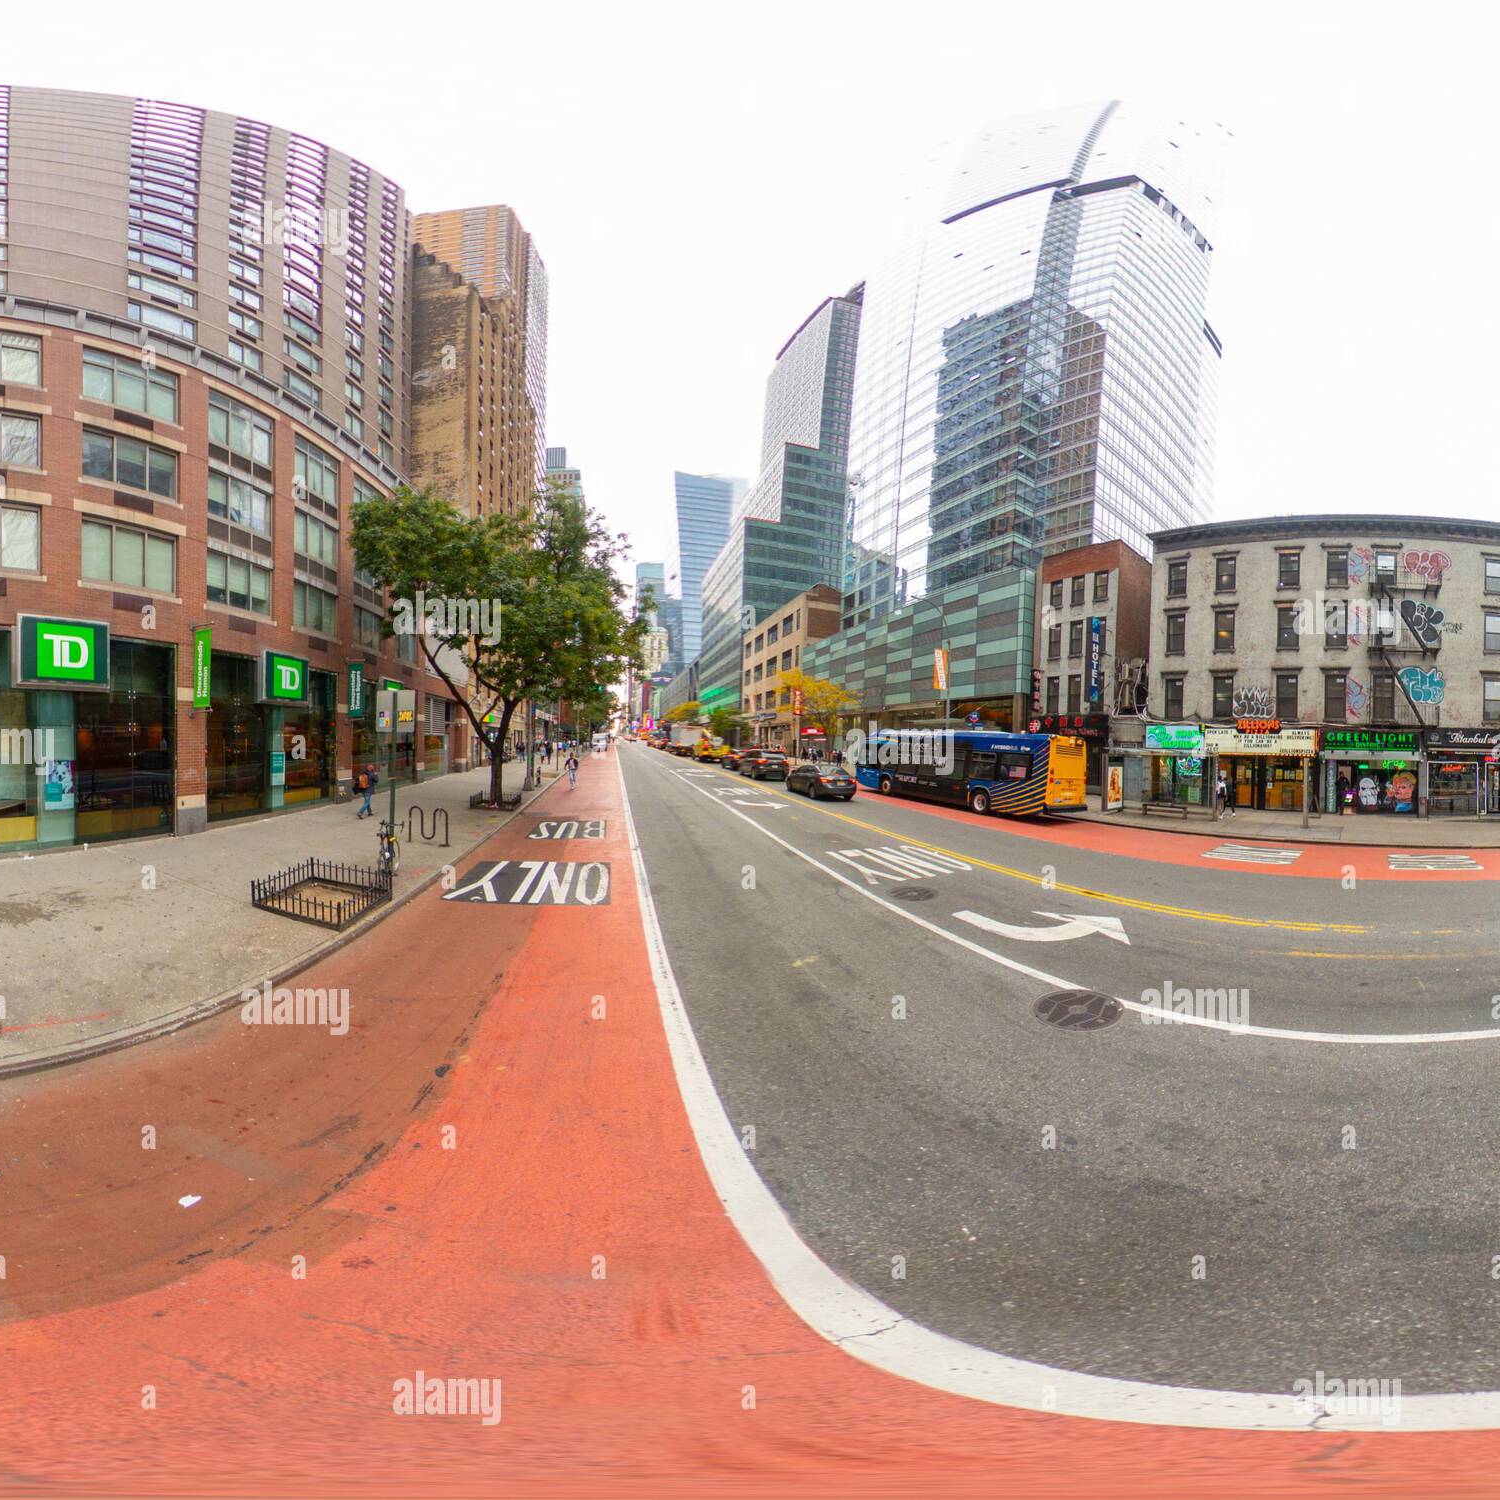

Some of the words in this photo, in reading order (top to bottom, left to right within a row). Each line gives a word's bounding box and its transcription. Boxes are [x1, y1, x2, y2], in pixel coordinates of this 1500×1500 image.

[43, 634, 89, 668] TD
[277, 665, 299, 690] TD
[1091, 643, 1100, 687] HOTEL
[1237, 720, 1280, 730] ZILLIONS
[1326, 732, 1369, 742] GREEN
[1375, 733, 1414, 743] LIGHT
[1449, 730, 1490, 744] Istanbul
[528, 819, 605, 840] BUS
[826, 845, 973, 885] ONLY
[442, 860, 610, 905] ONLY
